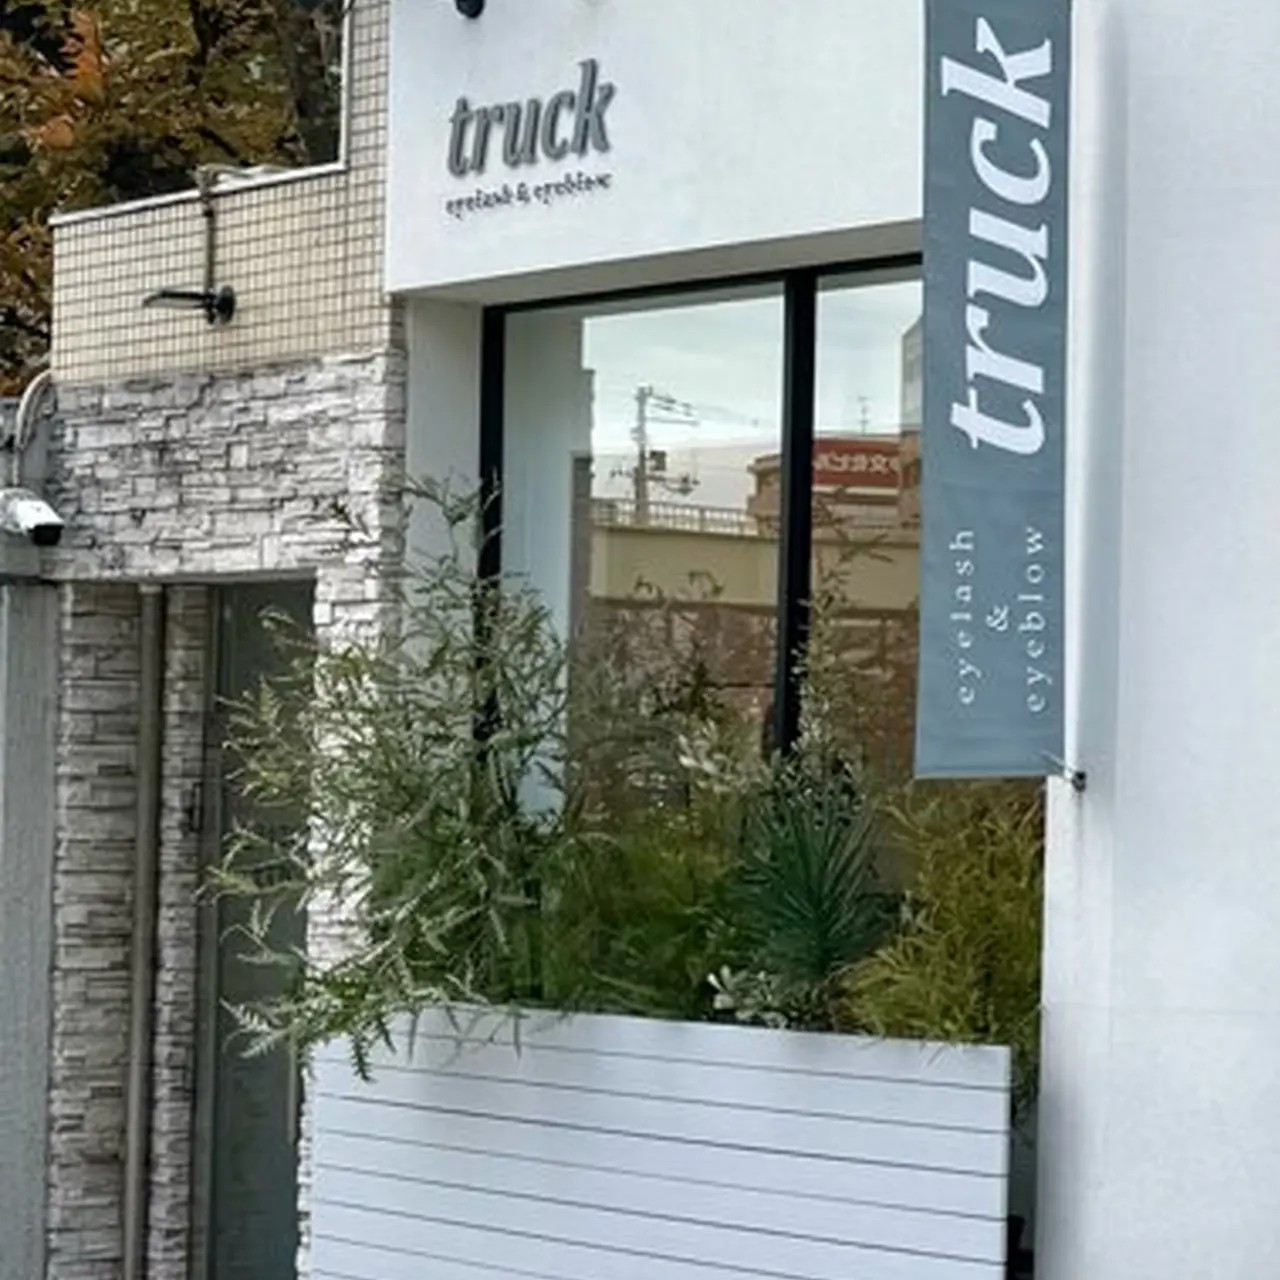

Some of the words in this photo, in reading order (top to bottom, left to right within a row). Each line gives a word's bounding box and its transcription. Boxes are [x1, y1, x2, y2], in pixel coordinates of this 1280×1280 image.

[447, 58, 617, 177] truck
[941, 16, 1053, 456] truck
[949, 530, 982, 705] eyelash
[985, 604, 1009, 632] &
[1018, 526, 1053, 713] eyeblow
